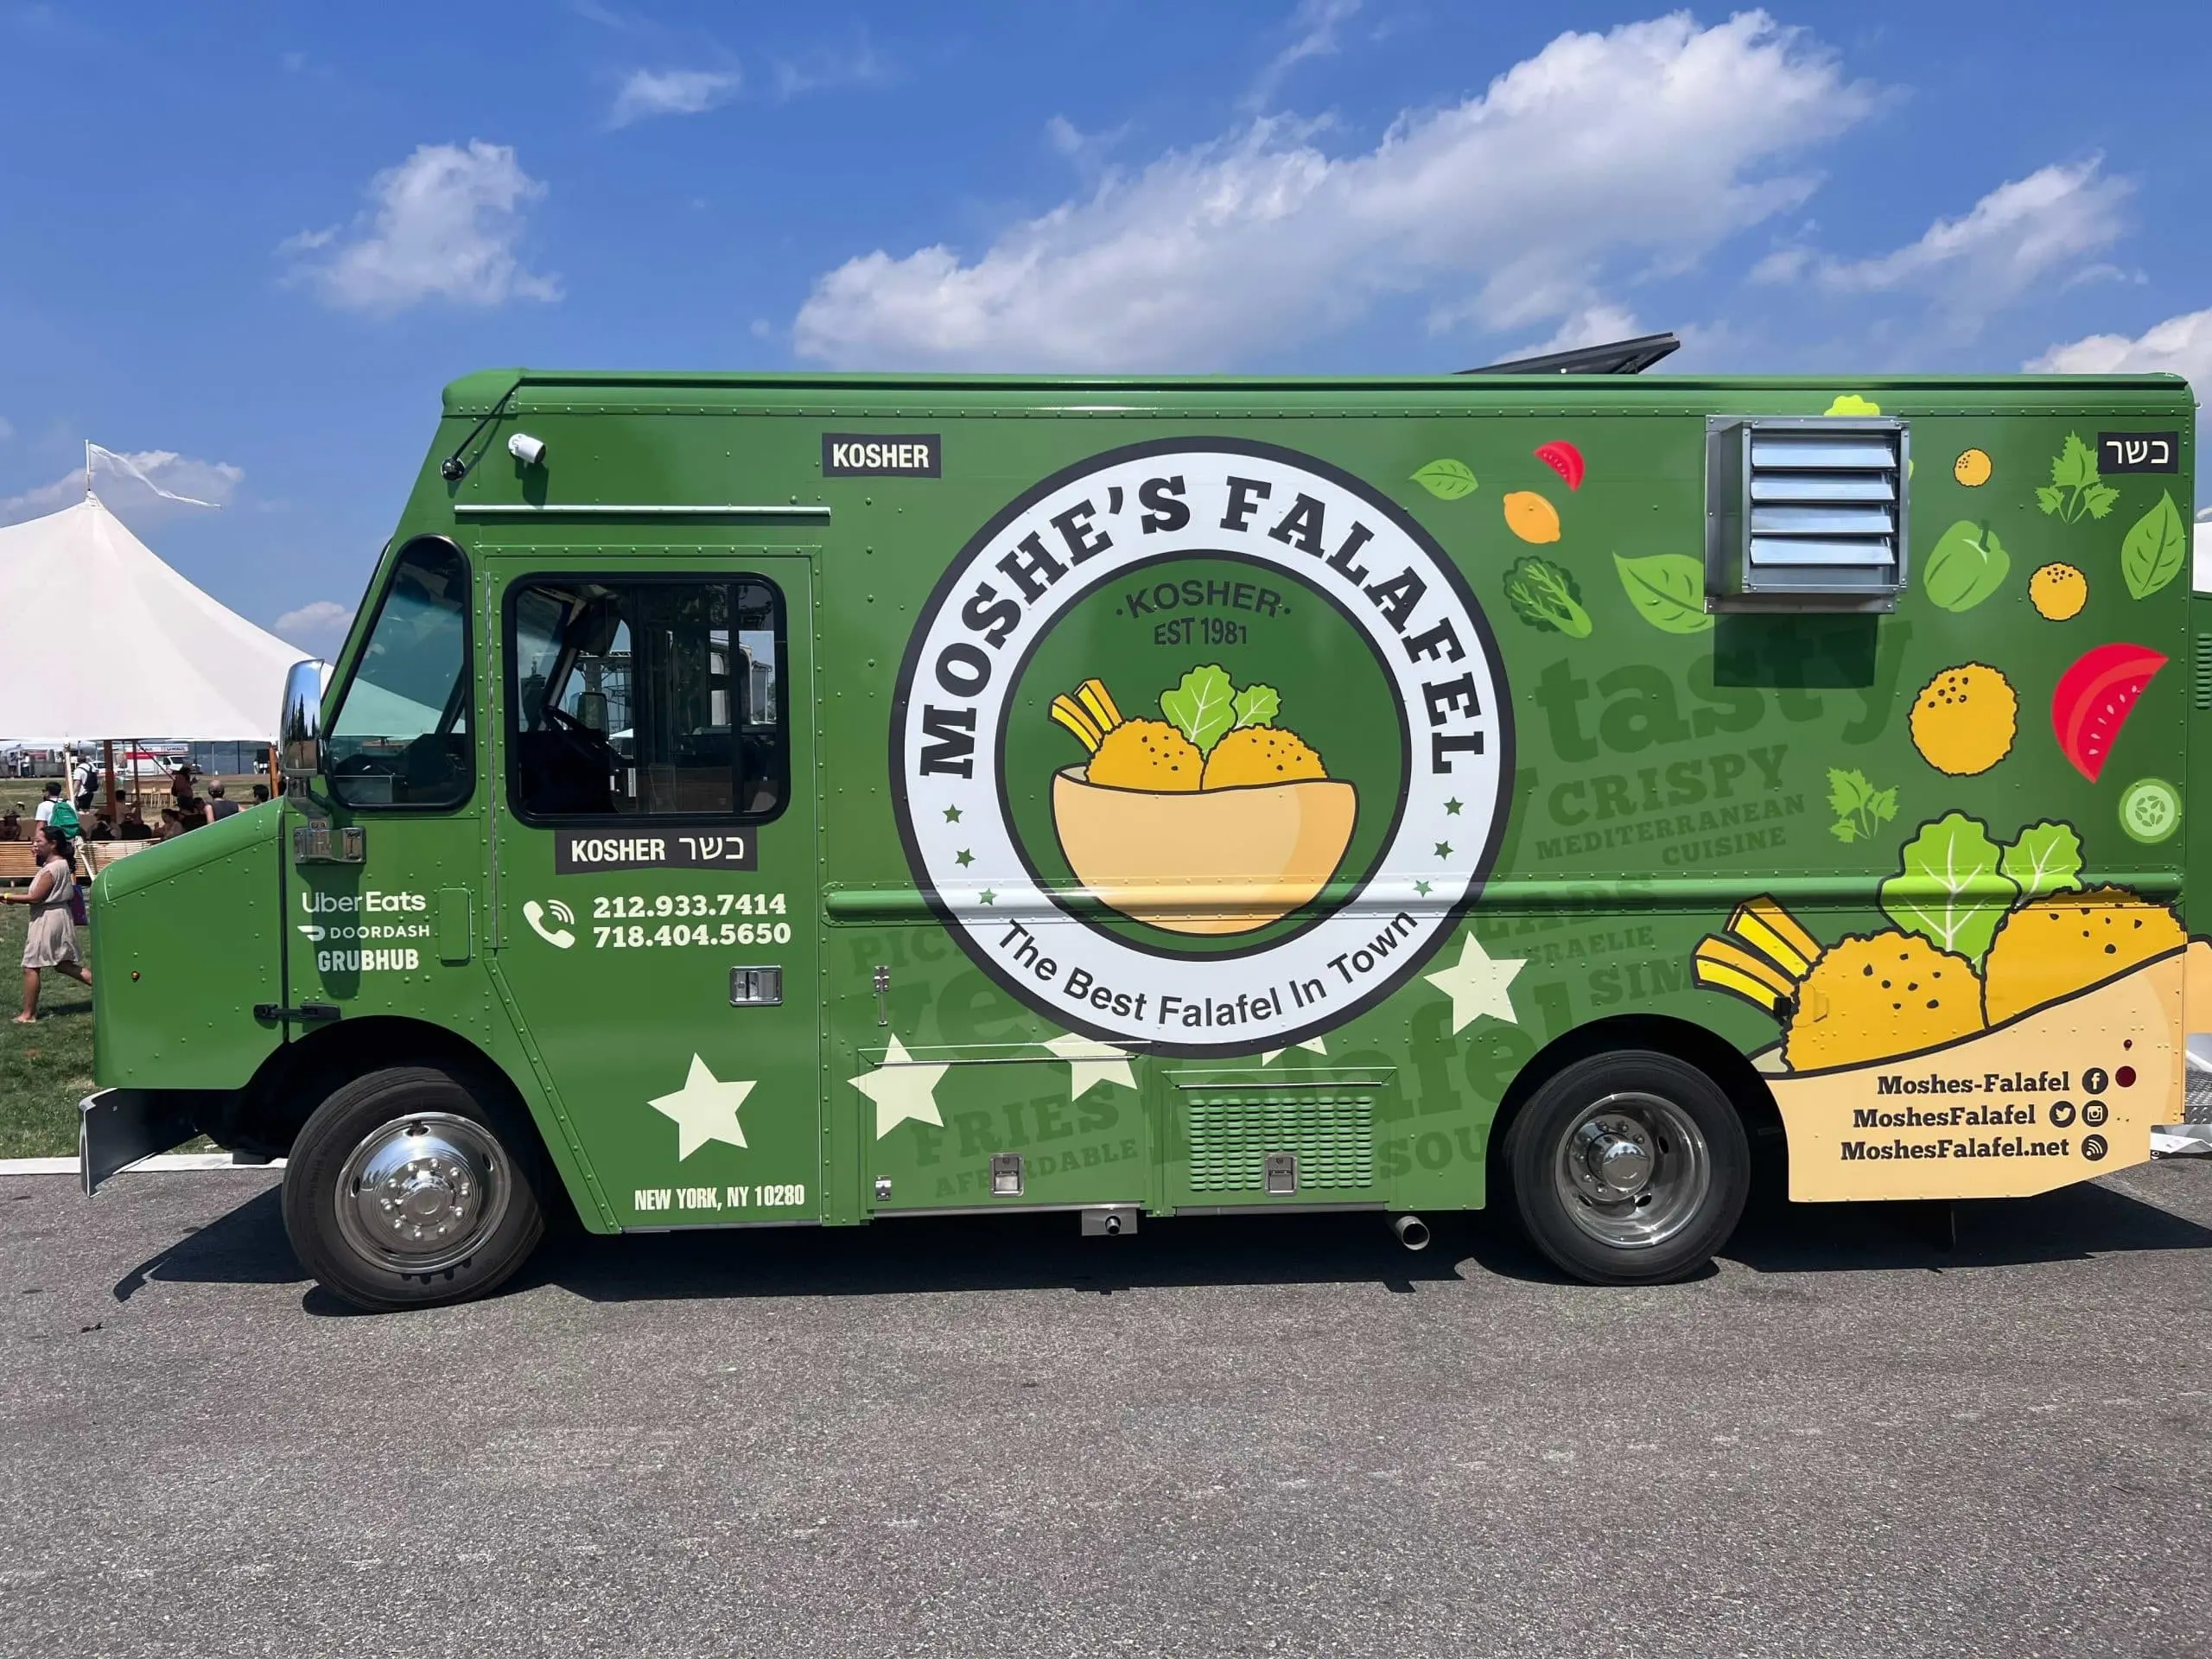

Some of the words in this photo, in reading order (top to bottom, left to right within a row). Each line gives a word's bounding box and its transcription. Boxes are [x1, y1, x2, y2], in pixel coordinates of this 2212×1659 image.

[832, 443, 930, 469] KOSHER
[2106, 441, 2170, 465] כשר
[918, 474, 1192, 780] MOSHE'S
[1219, 474, 1485, 776] FALAFEL
[1154, 616, 1196, 645] EST
[1200, 617, 1248, 645] 1981
[1548, 743, 1789, 827] CRISPY
[1535, 792, 1806, 861] MEDITERRANEAN
[571, 838, 666, 862] KOSHER
[678, 836, 745, 861] כשר
[1661, 825, 1788, 866] CUISINE
[593, 893, 787, 918] 212.933.7414
[330, 924, 430, 939] DOORDASH
[593, 922, 791, 949] 718.404.5650
[317, 948, 419, 972] GRUBHUB
[998, 918, 1058, 982] The
[1062, 966, 1147, 1022] Best
[1159, 987, 1283, 1028] Falafel
[1289, 978, 1328, 1009] In
[1325, 912, 1418, 984] Town
[1877, 1071, 2070, 1095] Moshes-Falafel
[910, 1083, 1120, 1168] FRIES
[1853, 1103, 2036, 1128] MoshesFalafel
[1840, 1136, 2069, 1160] MoshesFalafel.net
[634, 1188, 672, 1211] NEW
[676, 1186, 723, 1211] YORK,
[727, 1185, 750, 1208] NY
[754, 1184, 805, 1207] 10280
